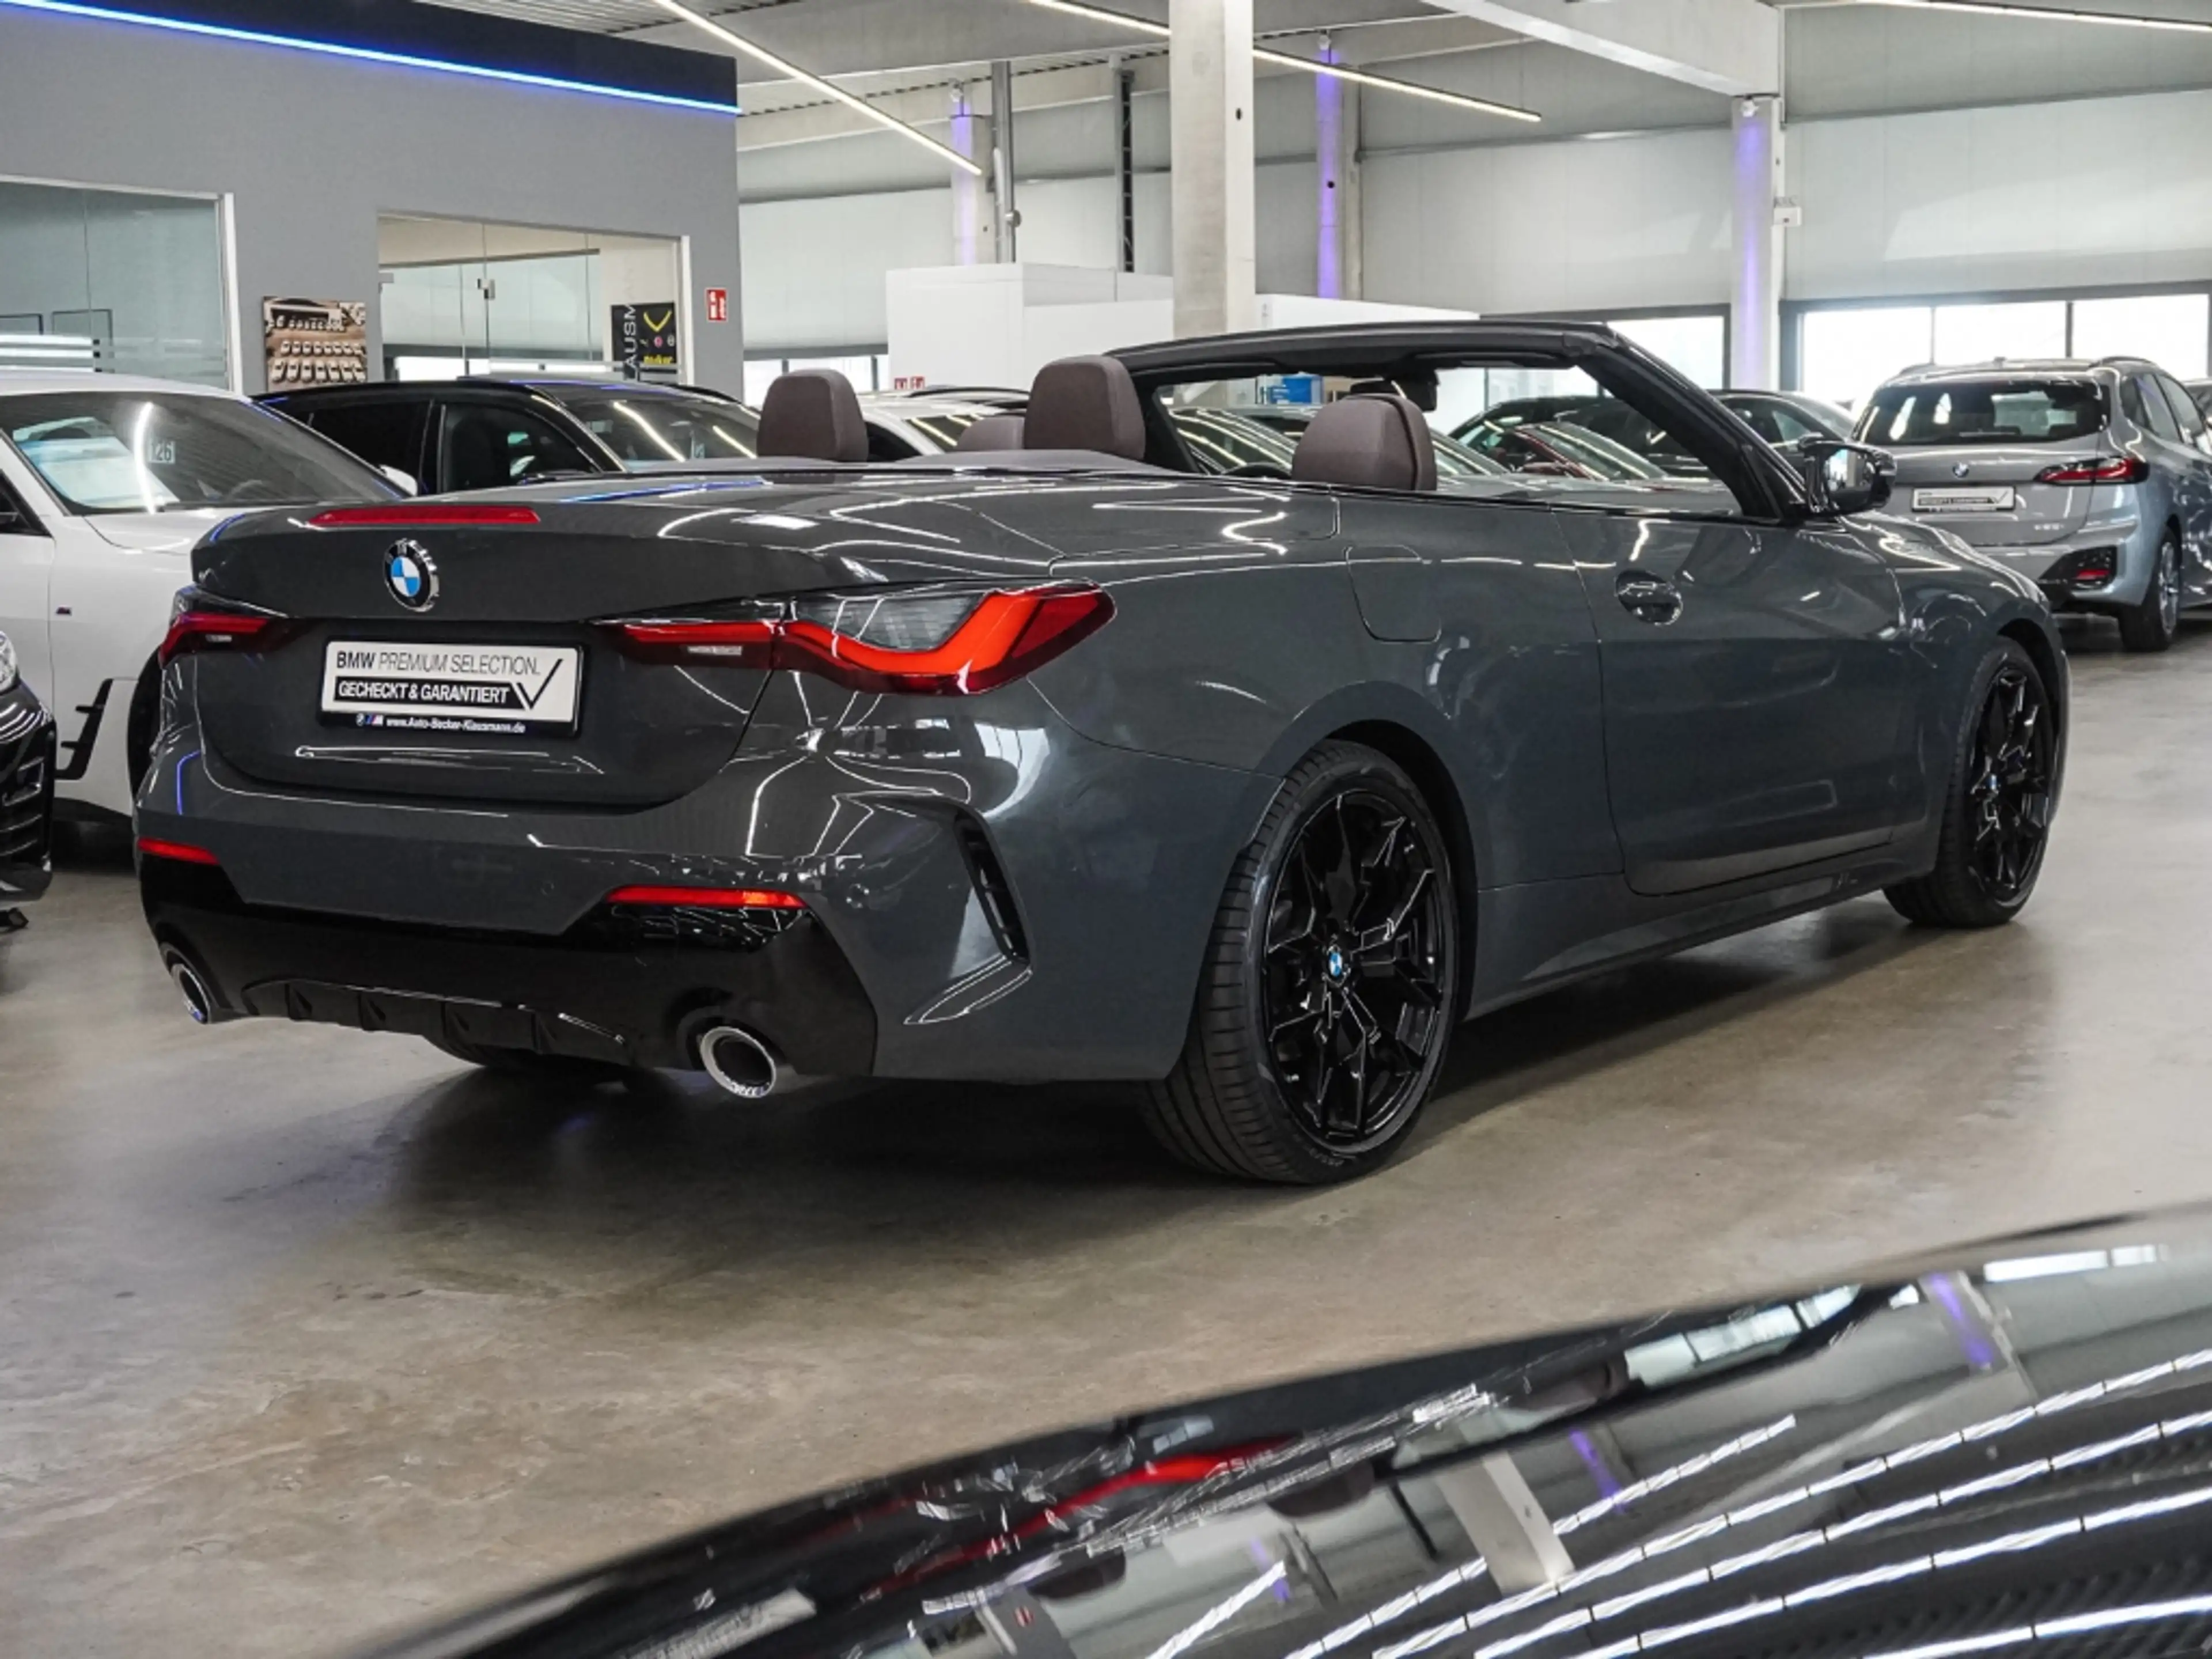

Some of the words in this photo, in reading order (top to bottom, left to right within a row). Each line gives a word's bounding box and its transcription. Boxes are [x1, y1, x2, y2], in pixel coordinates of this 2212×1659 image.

[336, 651, 376, 669] BMW
[378, 652, 449, 673] PREMIUM
[339, 680, 408, 700] GECHECKT
[408, 683, 418, 700] &
[421, 683, 510, 704] GARANTIERT
